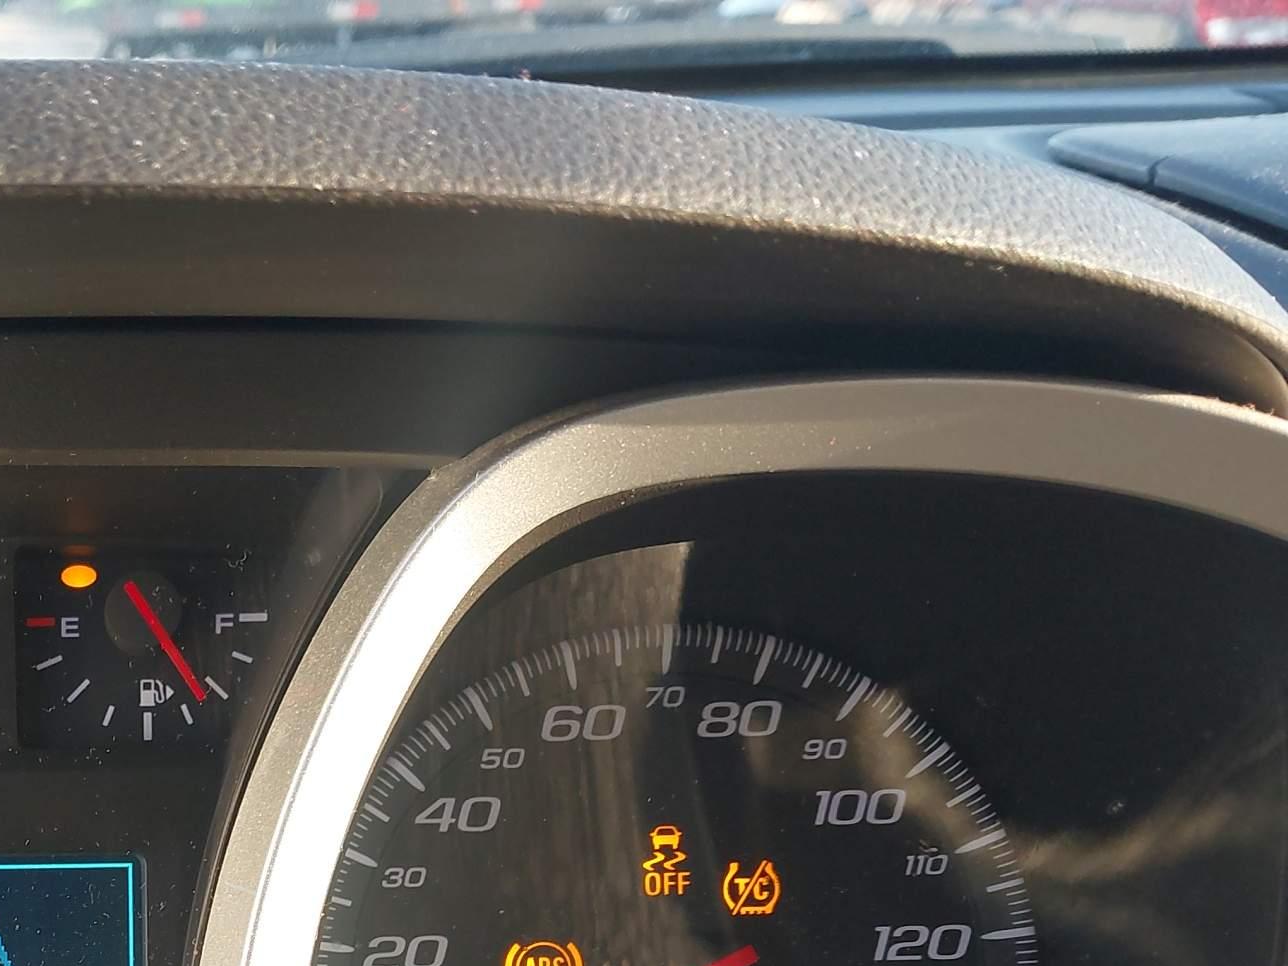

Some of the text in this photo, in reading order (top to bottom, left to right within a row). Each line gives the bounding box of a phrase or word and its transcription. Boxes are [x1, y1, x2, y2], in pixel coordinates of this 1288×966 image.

[60, 616, 80, 638] E
[214, 613, 234, 634] F
[645, 686, 686, 709] 70
[540, 704, 626, 741] 60
[696, 700, 782, 737] 80
[480, 747, 525, 770] 50
[802, 738, 848, 761] 90
[414, 796, 500, 833] 40
[814, 788, 908, 826] 100
[381, 866, 427, 888] 30
[904, 854, 948, 877] 110
[644, 872, 691, 897] OFF
[873, 925, 972, 962] 120
